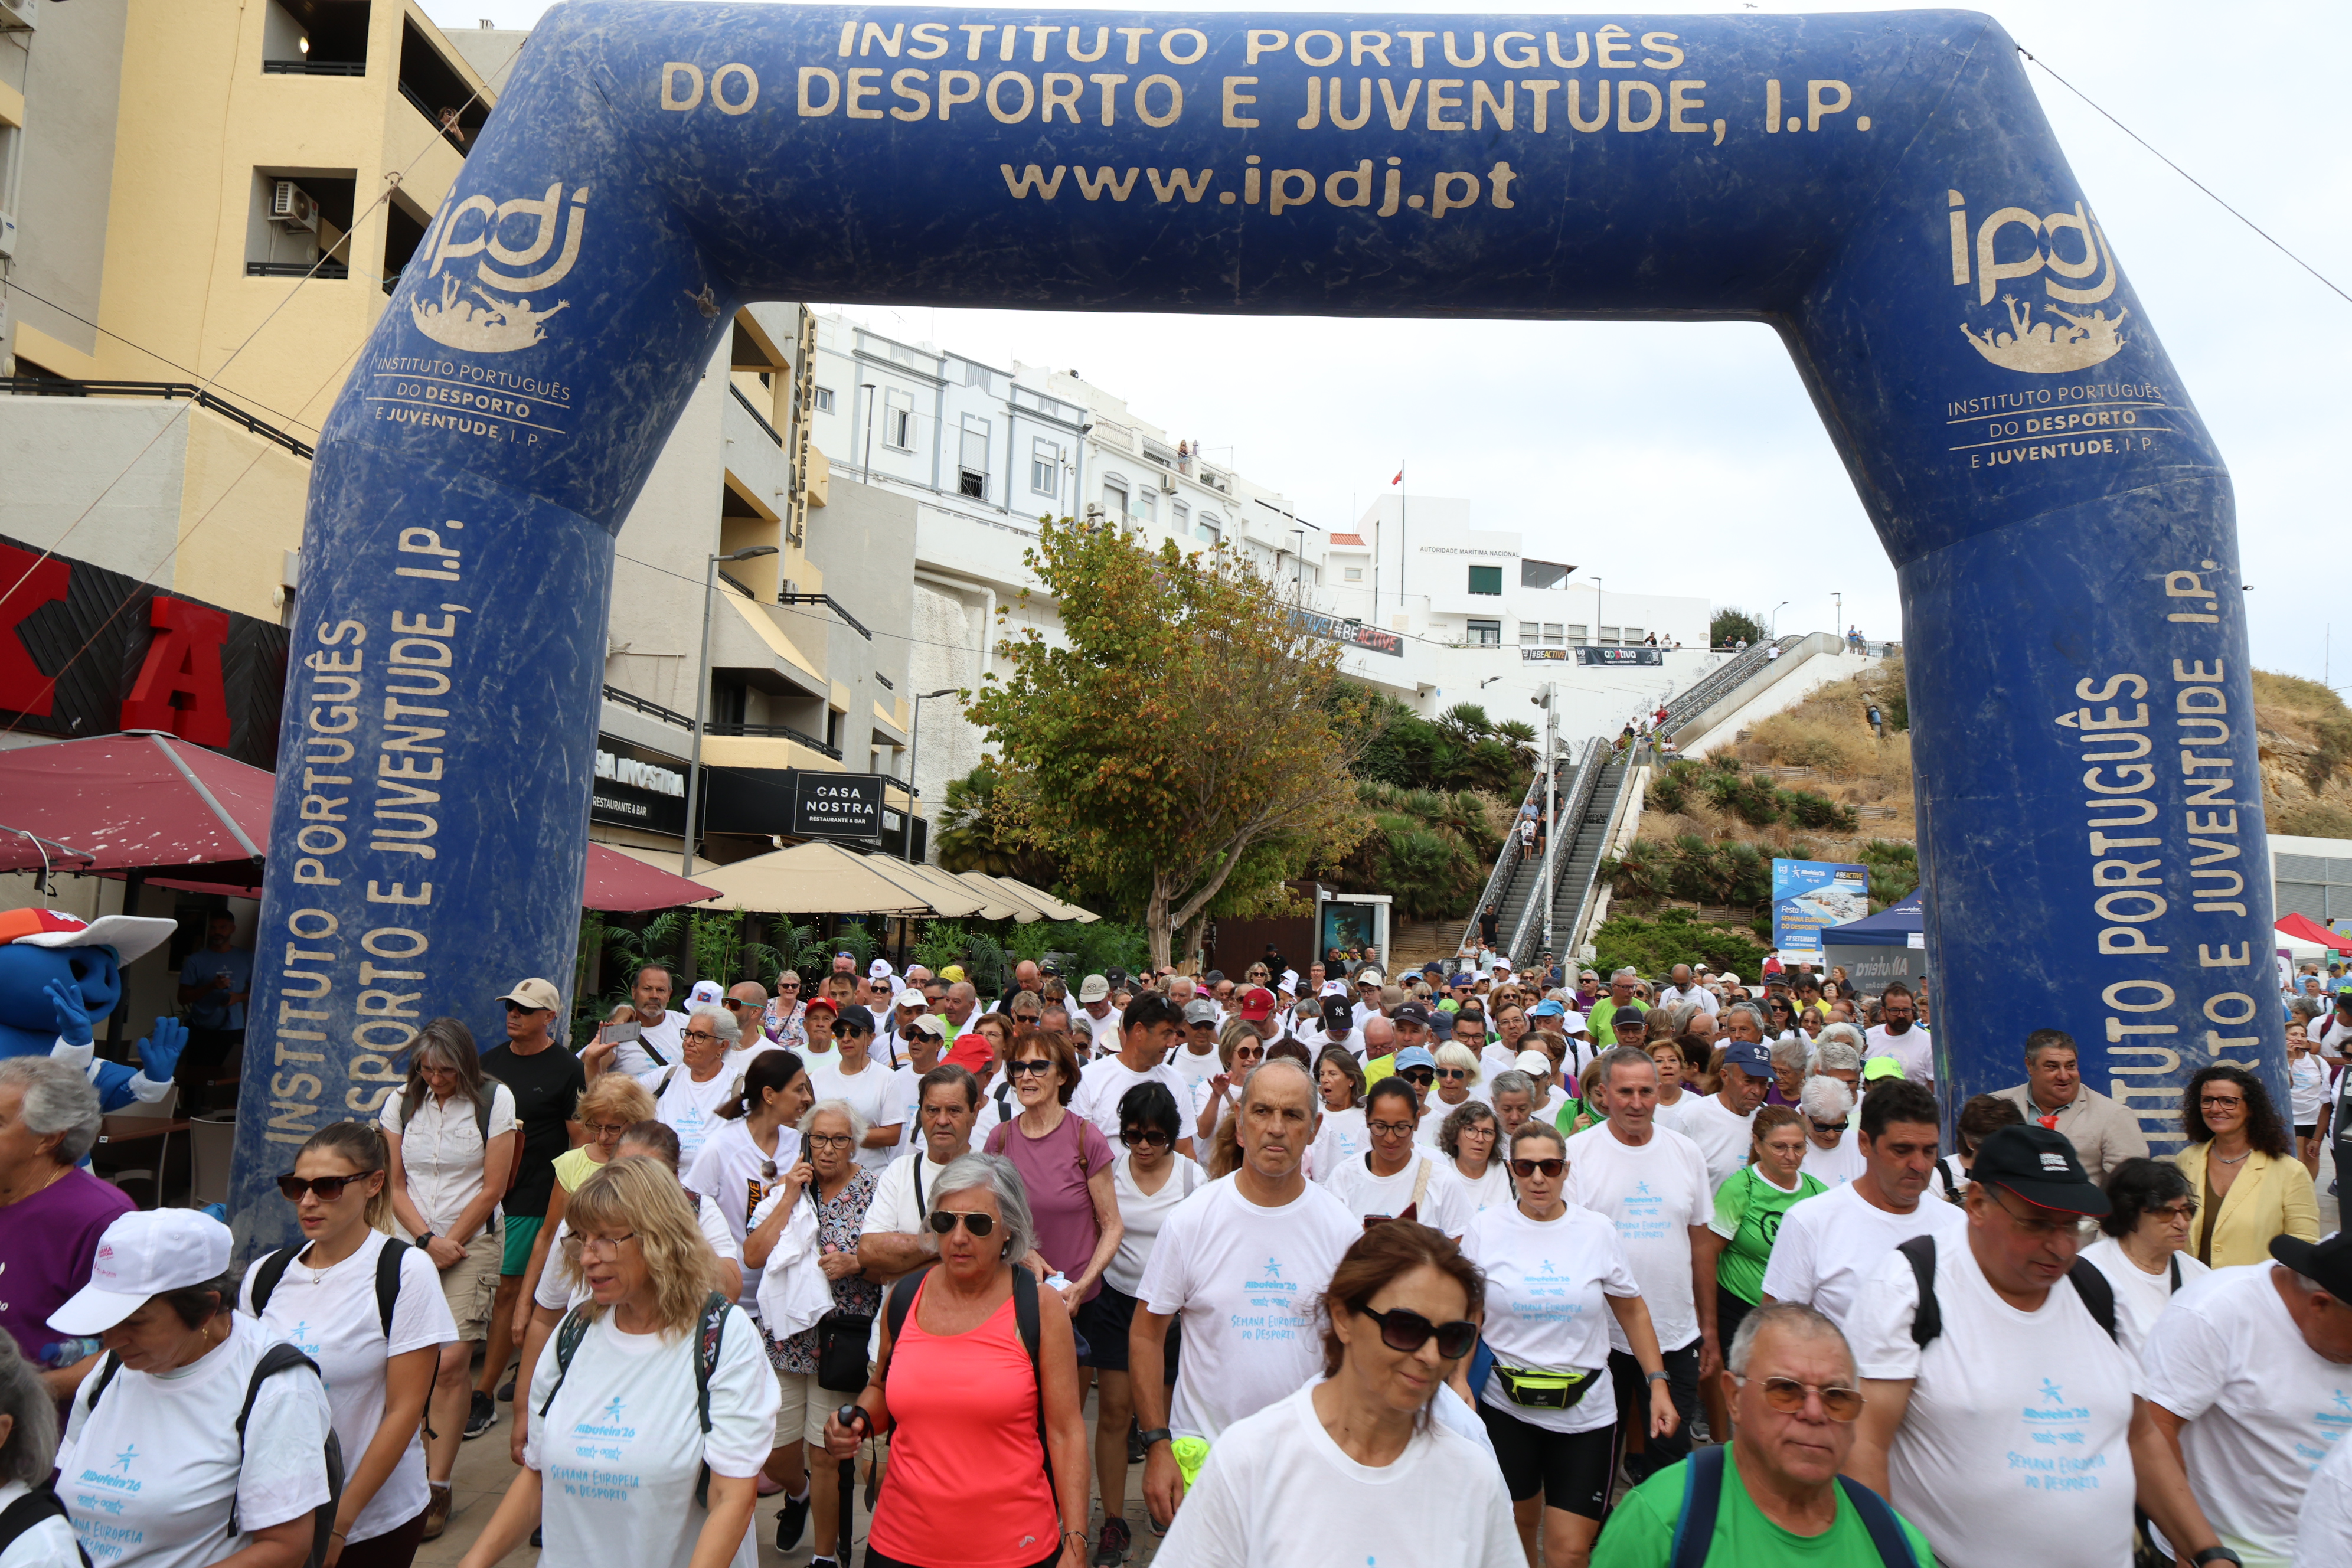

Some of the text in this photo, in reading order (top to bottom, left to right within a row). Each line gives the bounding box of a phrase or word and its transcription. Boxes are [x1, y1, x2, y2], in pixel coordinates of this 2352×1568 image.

[838, 21, 1684, 69] INSTITUTO PORTUGUÊS
[661, 61, 1871, 146] DO DESPORTO E JUVENTUDE, I.P.
[1000, 155, 1518, 218] www.ipdj.pt
[422, 182, 589, 292] ipdj
[1948, 188, 2116, 305] ipdj
[377, 357, 570, 401] INSTITUTO PORTUGUÊS
[397, 383, 530, 418] DO DESPORTO
[1948, 383, 2162, 417] INSTITUTO PORTUGUÊS
[375, 407, 384, 419] E
[387, 408, 503, 442] JUVENTUDE,
[1990, 411, 2137, 438] DO DESPORTO
[1972, 455, 1981, 468] E
[1987, 439, 2120, 467] JUVENTUDE,
[394, 520, 464, 582] I.P.
[1420, 546, 1458, 554] AUTORIDADE
[2164, 560, 2220, 623] I.P.
[1334, 622, 1397, 652] #BEACTIVE
[1531, 649, 1566, 659] #BEACTIVE
[1604, 649, 1636, 659] apptiva
[370, 603, 472, 860] JUVENTUDE,
[616, 758, 685, 798] NOSTRA
[2173, 658, 2247, 917] JUVENTUDE
[816, 786, 861, 798] CASA
[592, 796, 631, 814] RESTAURANTE
[636, 805, 647, 816] BAR
[806, 801, 874, 814] NOSTRA
[2054, 673, 2170, 955] PORTUGUÊS
[265, 619, 367, 1144] INSTITUTO PORTUGUÊS
[1835, 871, 1864, 880] #BEACTIVE
[366, 880, 432, 906] E
[1781, 905, 1799, 914] Festa
[2198, 940, 2251, 968] E
[1335, 1006, 1344, 1017] NY
[1244, 1280, 1297, 1290] Albufeira'26
[1512, 1302, 1582, 1313] SEMANA EUROPEIA
[1534, 1313, 1572, 1322] DESPORTO
[1231, 1315, 1265, 1328] SEMANA
[1242, 1329, 1295, 1341] DO DESPORTO
[575, 1423, 635, 1438] Albufeira'26
[2007, 1451, 2055, 1472] SEMANA
[80, 1469, 141, 1492] Albufeira'26
[551, 1464, 639, 1488] SEMANA EUROPEIA
[565, 1484, 627, 1501] DO DESPORTO
[93, 1521, 143, 1544] EUROPEIA
